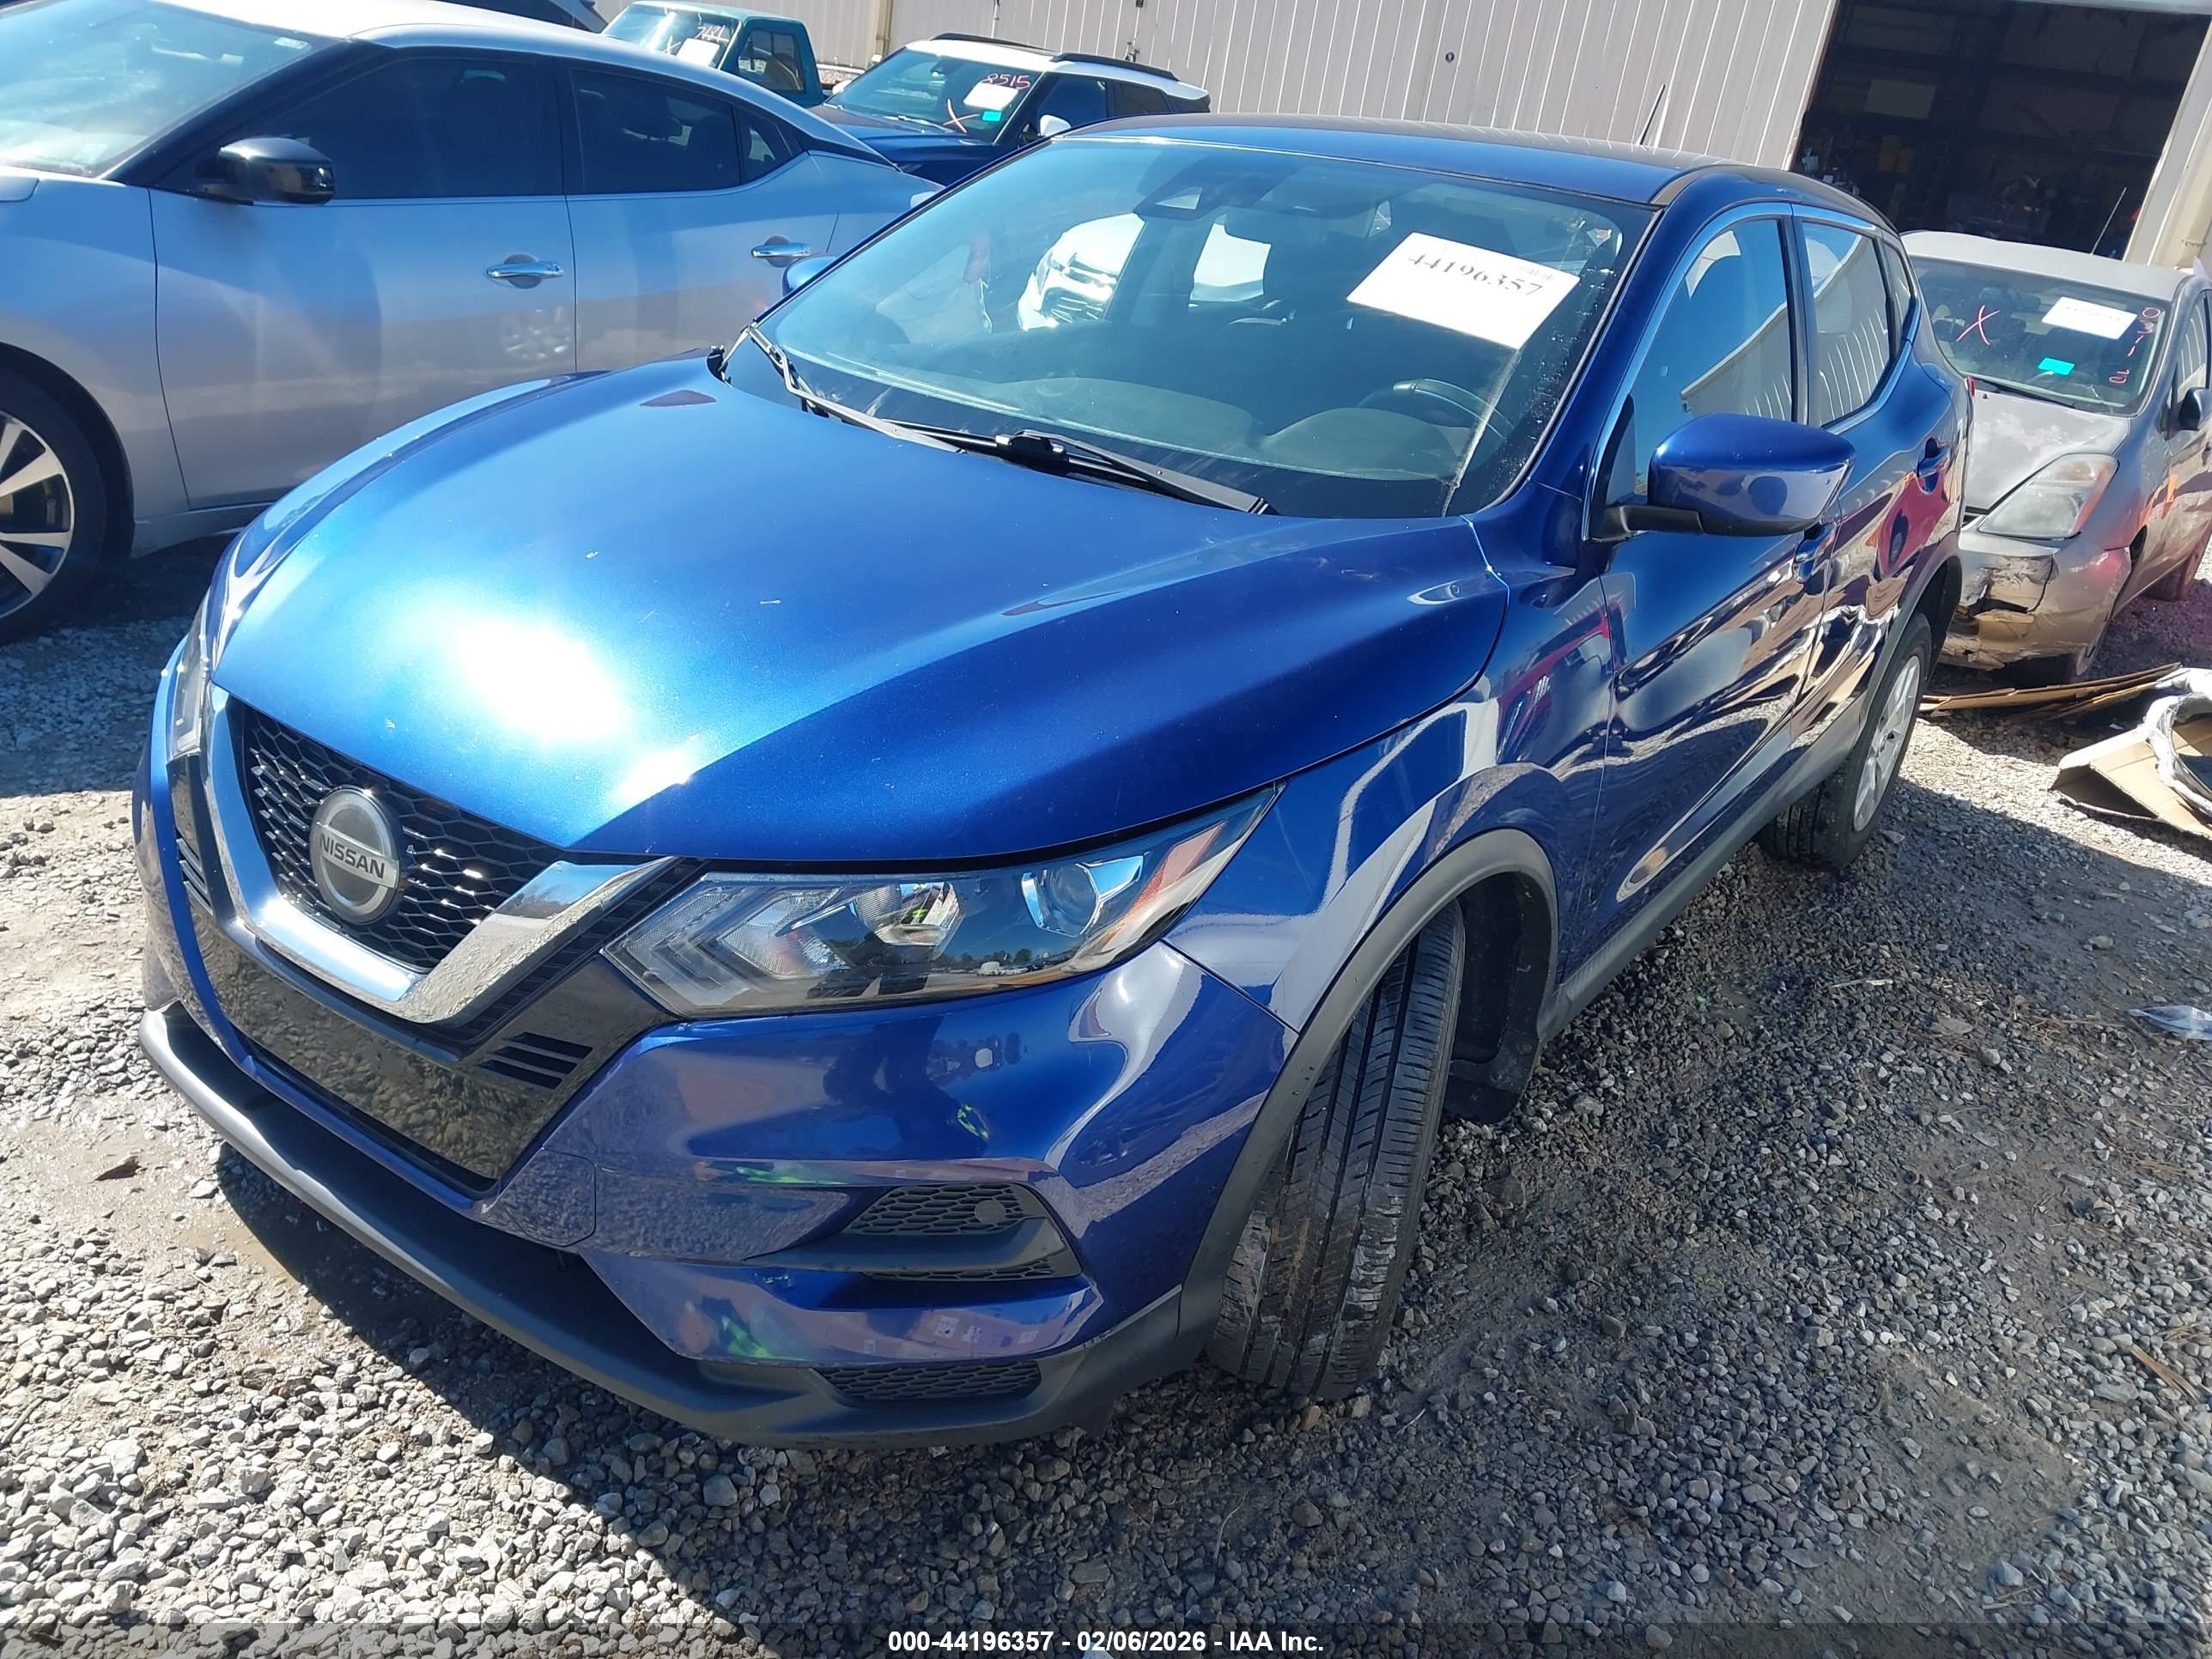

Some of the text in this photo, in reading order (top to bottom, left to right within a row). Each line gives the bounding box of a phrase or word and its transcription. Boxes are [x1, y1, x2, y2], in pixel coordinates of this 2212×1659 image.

[980, 72, 1031, 90] 8515
[1407, 252, 1545, 296] 44196357
[319, 833, 386, 880] NISSAN
